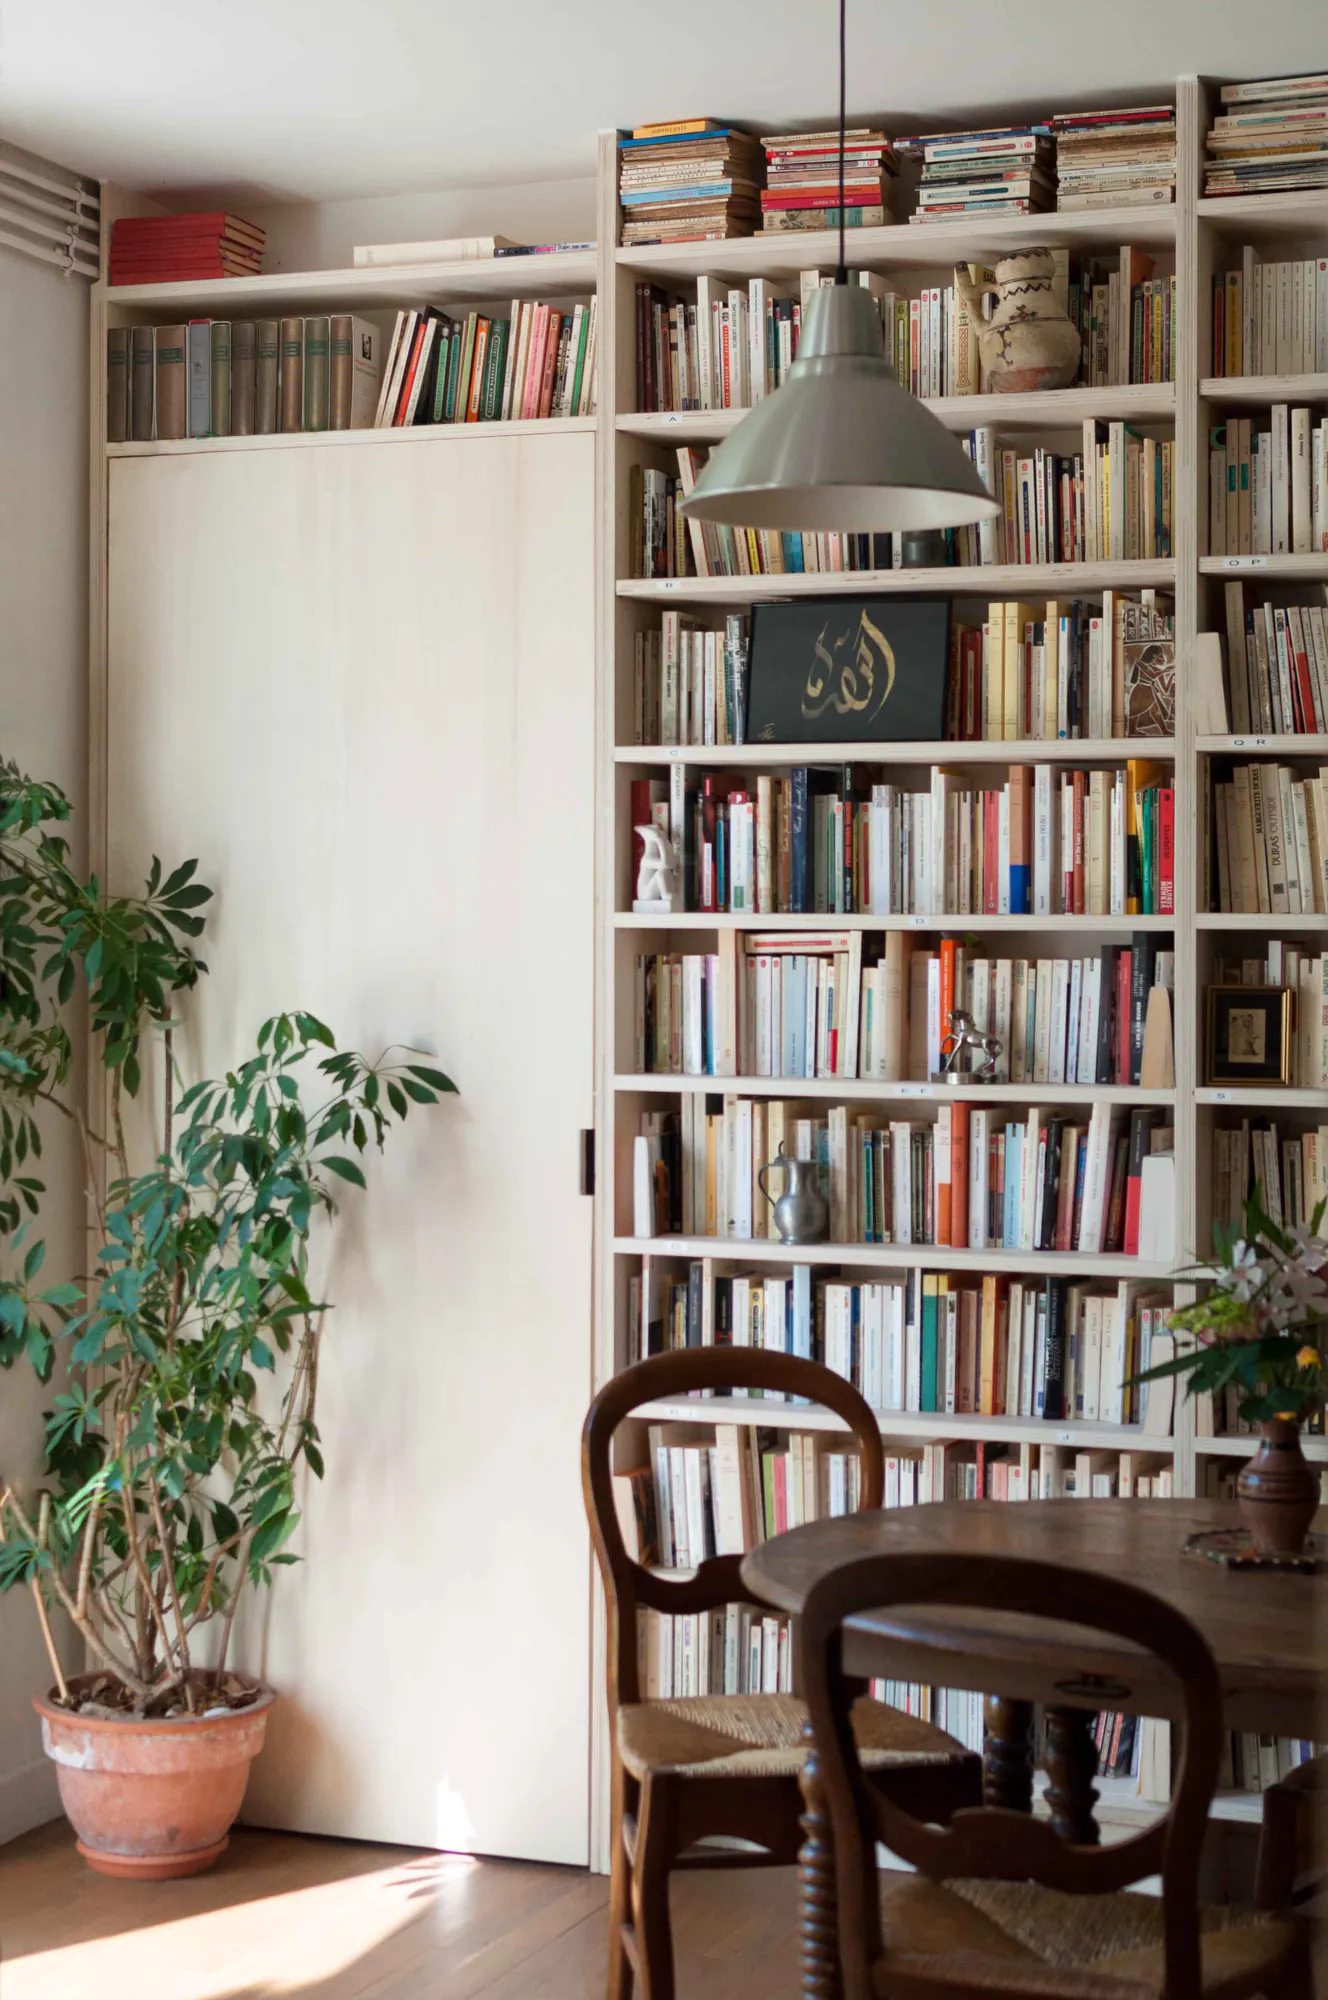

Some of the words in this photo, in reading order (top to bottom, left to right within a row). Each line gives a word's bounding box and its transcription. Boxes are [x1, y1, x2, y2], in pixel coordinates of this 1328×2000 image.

[1252, 768, 1260, 790] DURAS
[1253, 791, 1263, 834] MARGUERITE
[1267, 796, 1278, 834] OUTSIDE
[1270, 836, 1281, 866] DURAS
